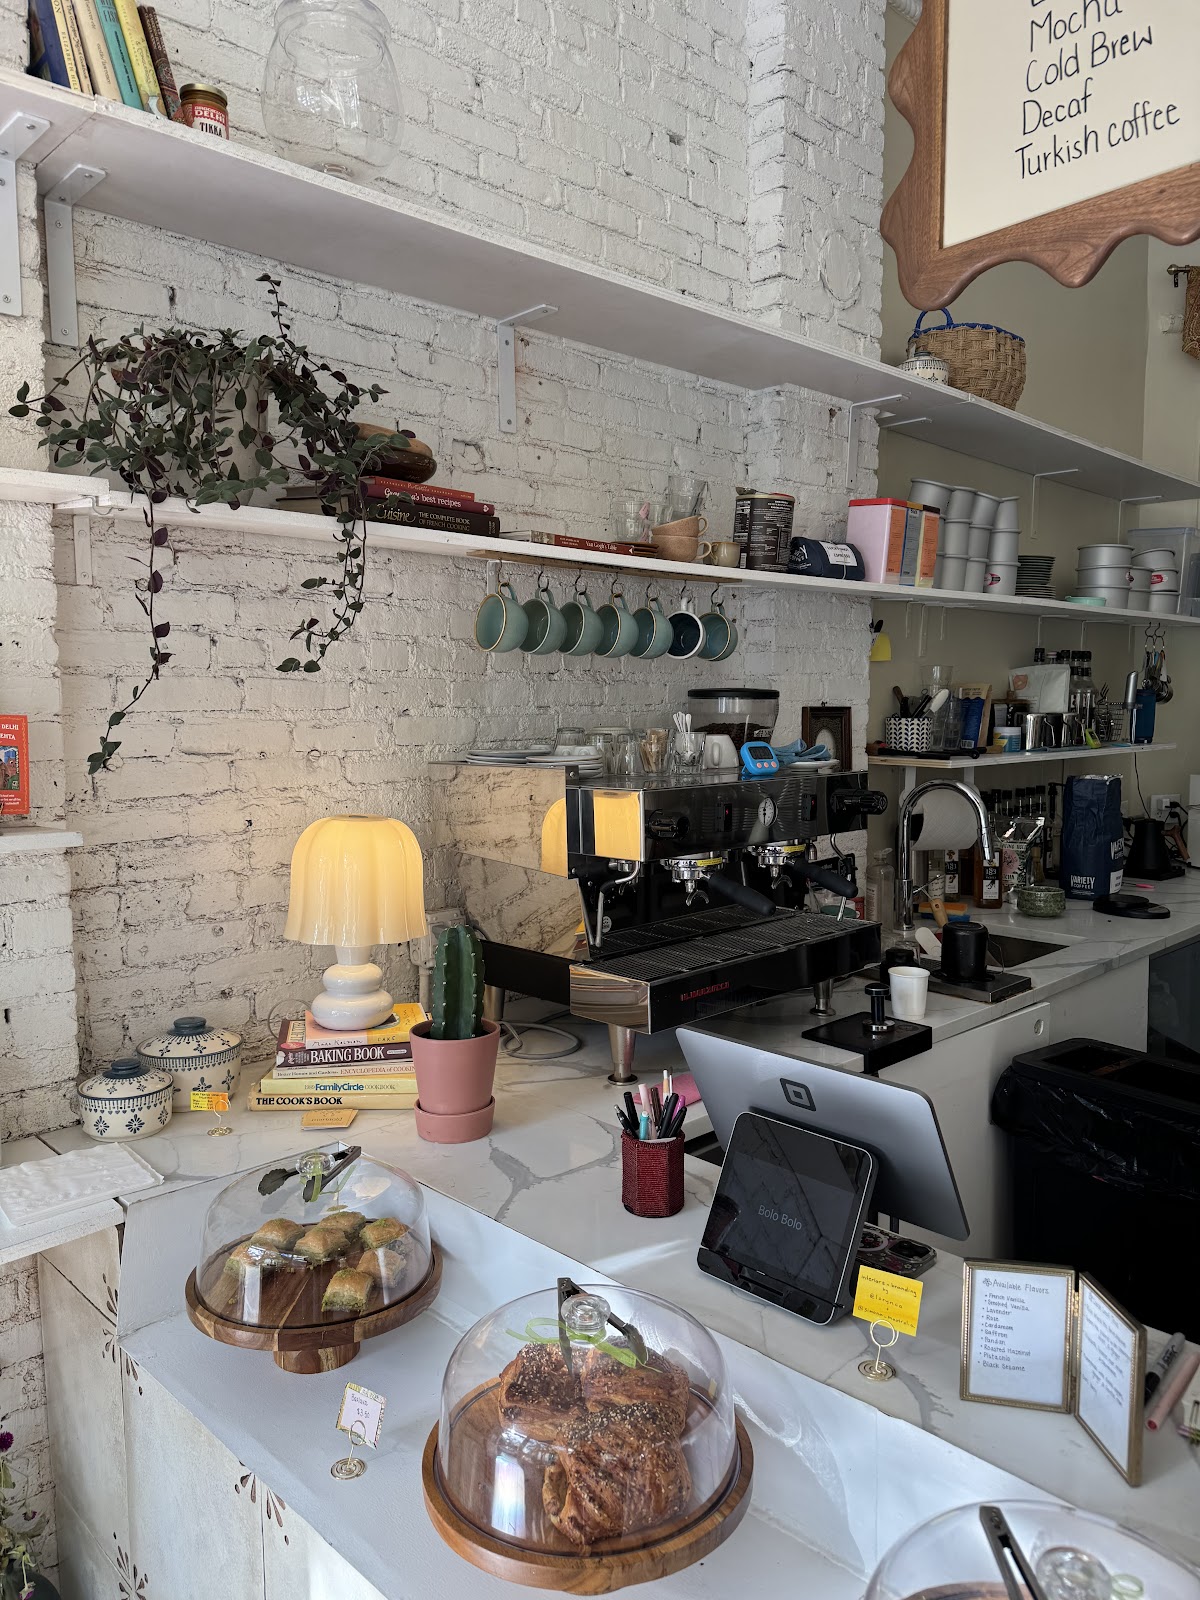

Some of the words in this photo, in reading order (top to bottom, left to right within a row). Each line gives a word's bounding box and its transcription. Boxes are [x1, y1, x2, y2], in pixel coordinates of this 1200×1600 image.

[1030, 0, 1123, 52] Mocha
[1026, 42, 1080, 92] Cold
[1090, 26, 1153, 68] Brew
[1022, 77, 1094, 135] Decaf
[195, 110, 225, 124] DELHI
[200, 122, 222, 138] TIKKA
[1015, 125, 1099, 180] Turkish
[1108, 100, 1181, 148] coffee
[422, 493, 436, 504] best
[438, 498, 461, 508] recipes
[430, 513, 455, 522] COMPLETE
[446, 522, 470, 531] COOKING
[1071, 875, 1095, 889] VARIETY
[310, 1048, 352, 1064] BAKING
[354, 1046, 385, 1060] BOOK
[256, 1097, 275, 1105] THE
[276, 1096, 313, 1105] COOK'S
[314, 1096, 343, 1105] BOOK
[758, 1205, 779, 1222] Bolo
[781, 1213, 802, 1230] Bolo
[891, 1283, 916, 1298] branding
[993, 1279, 1021, 1290] Available
[1025, 1284, 1050, 1294] Flavors
[988, 1299, 1007, 1308] Smoked
[987, 1307, 1011, 1315] Lavender
[985, 1329, 1008, 1338] Saffron
[985, 1336, 1005, 1345] Pandan
[984, 1344, 1005, 1353] Roasted
[984, 1352, 1010, 1361] Pistachio
[983, 1360, 999, 1368] Black
